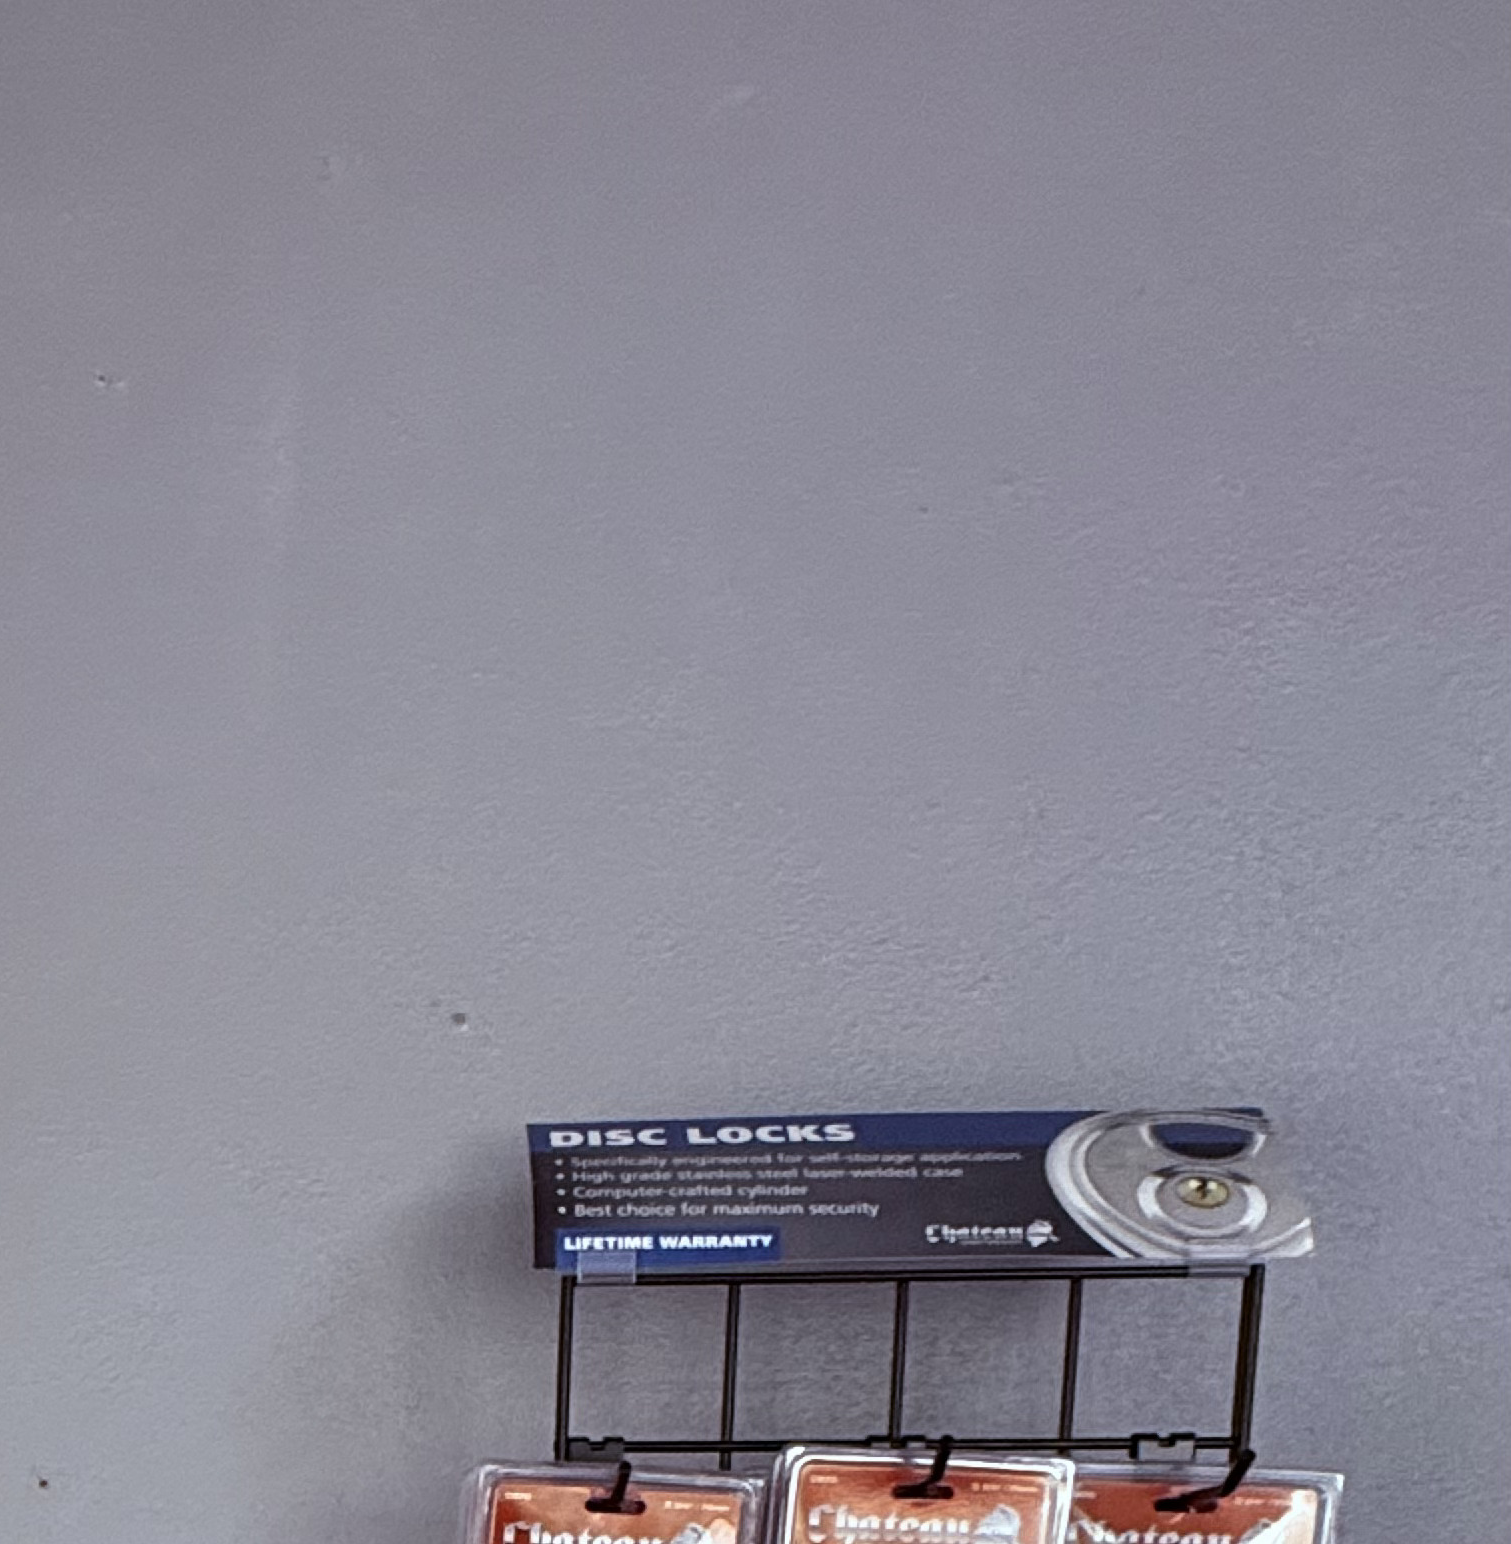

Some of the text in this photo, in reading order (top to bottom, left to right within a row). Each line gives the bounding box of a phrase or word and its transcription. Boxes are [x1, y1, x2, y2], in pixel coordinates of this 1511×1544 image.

[549, 1124, 855, 1147] DISC LOCKS
[571, 1155, 667, 1169] Specifically
[672, 1154, 772, 1168] engineered
[777, 1152, 803, 1164] for
[809, 1152, 914, 1164] self-storage
[572, 1171, 614, 1184] High
[620, 1170, 671, 1184] grade
[677, 1169, 752, 1180] stainless
[757, 1168, 797, 1179] steel
[922, 1168, 963, 1178] case
[737, 1184, 808, 1199] cylinder
[574, 1201, 880, 1218] Best choice for maximum security
[564, 1234, 773, 1250] LIFETIME WARRANTY
